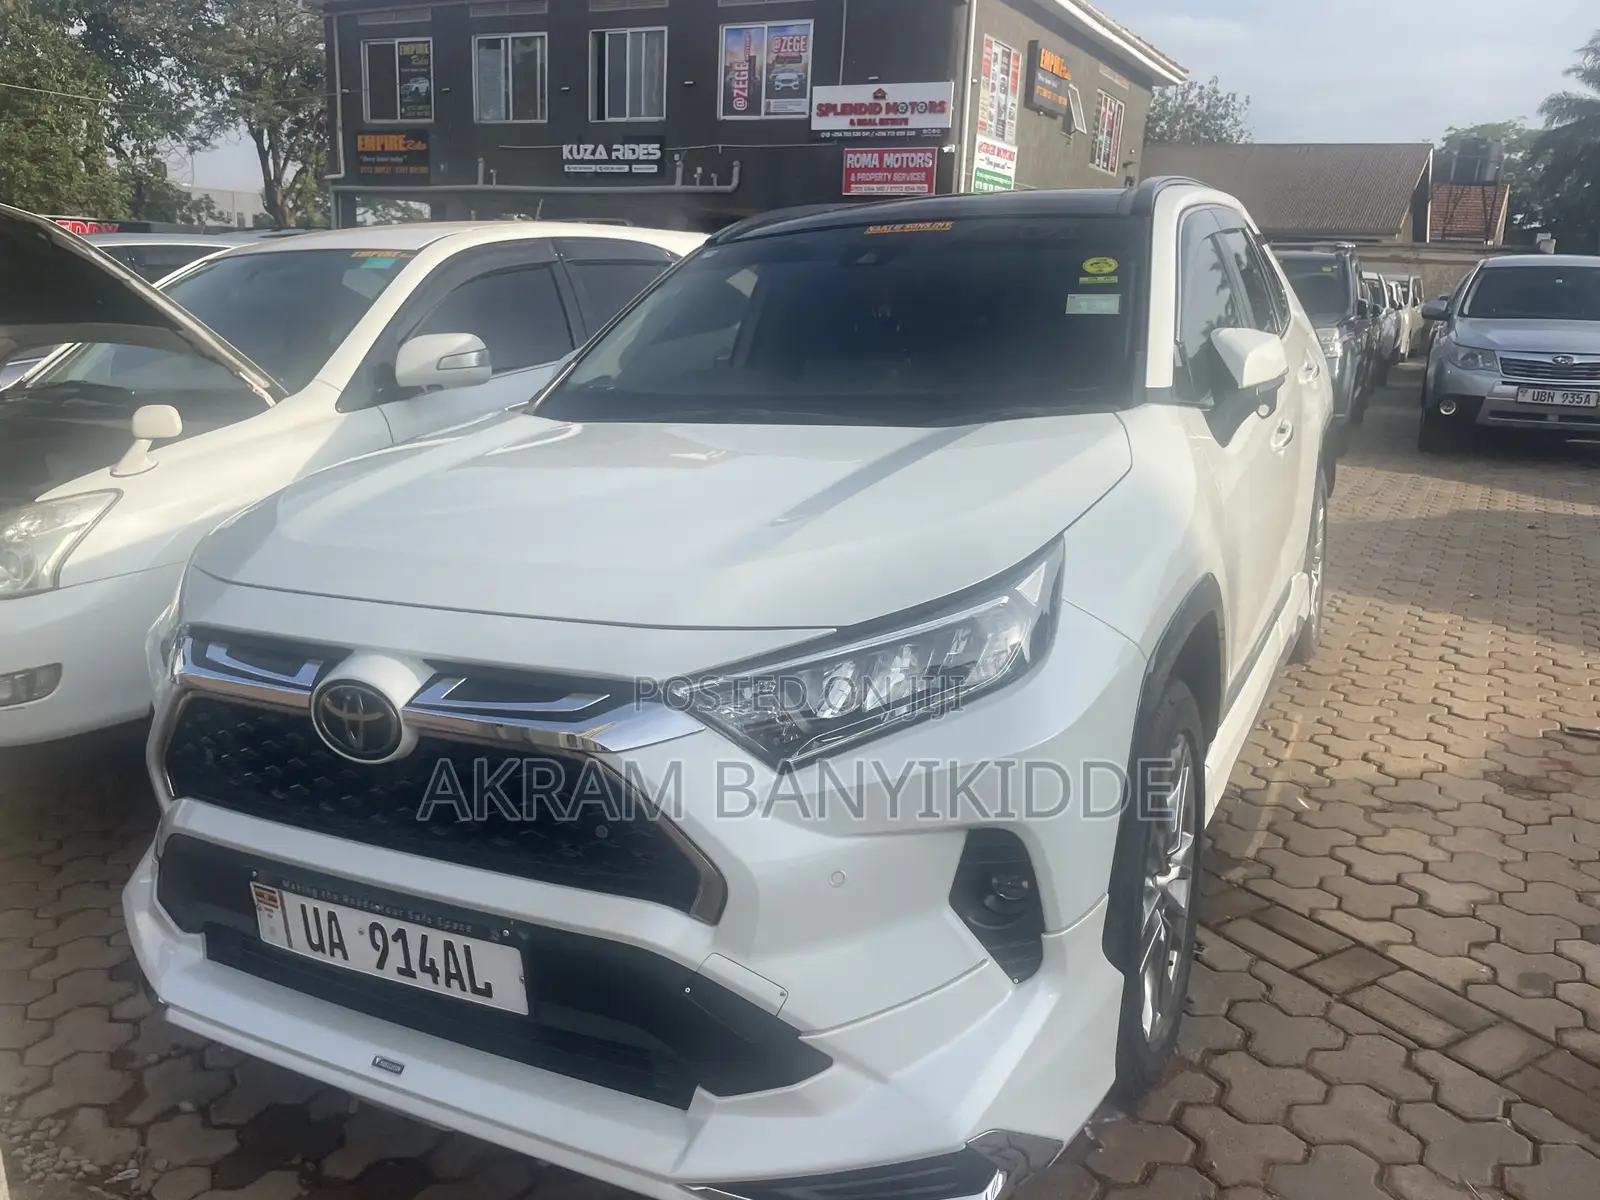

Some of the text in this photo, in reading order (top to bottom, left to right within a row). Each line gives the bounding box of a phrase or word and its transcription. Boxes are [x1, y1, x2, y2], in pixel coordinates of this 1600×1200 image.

[772, 35, 808, 53] @ZEGE
[733, 62, 749, 111] @ZEGE
[816, 102, 882, 117] SPLENDID
[885, 100, 948, 115] MOTORS
[357, 134, 406, 152] EMPIRE
[562, 144, 661, 160] KUZA RIDES
[846, 152, 933, 169] ROMA MOTORS
[857, 172, 892, 182] PROPERTY
[893, 172, 926, 182] SERVICES
[1532, 390, 1591, 405] UBN 935A
[300, 902, 493, 999] UA 914AL
